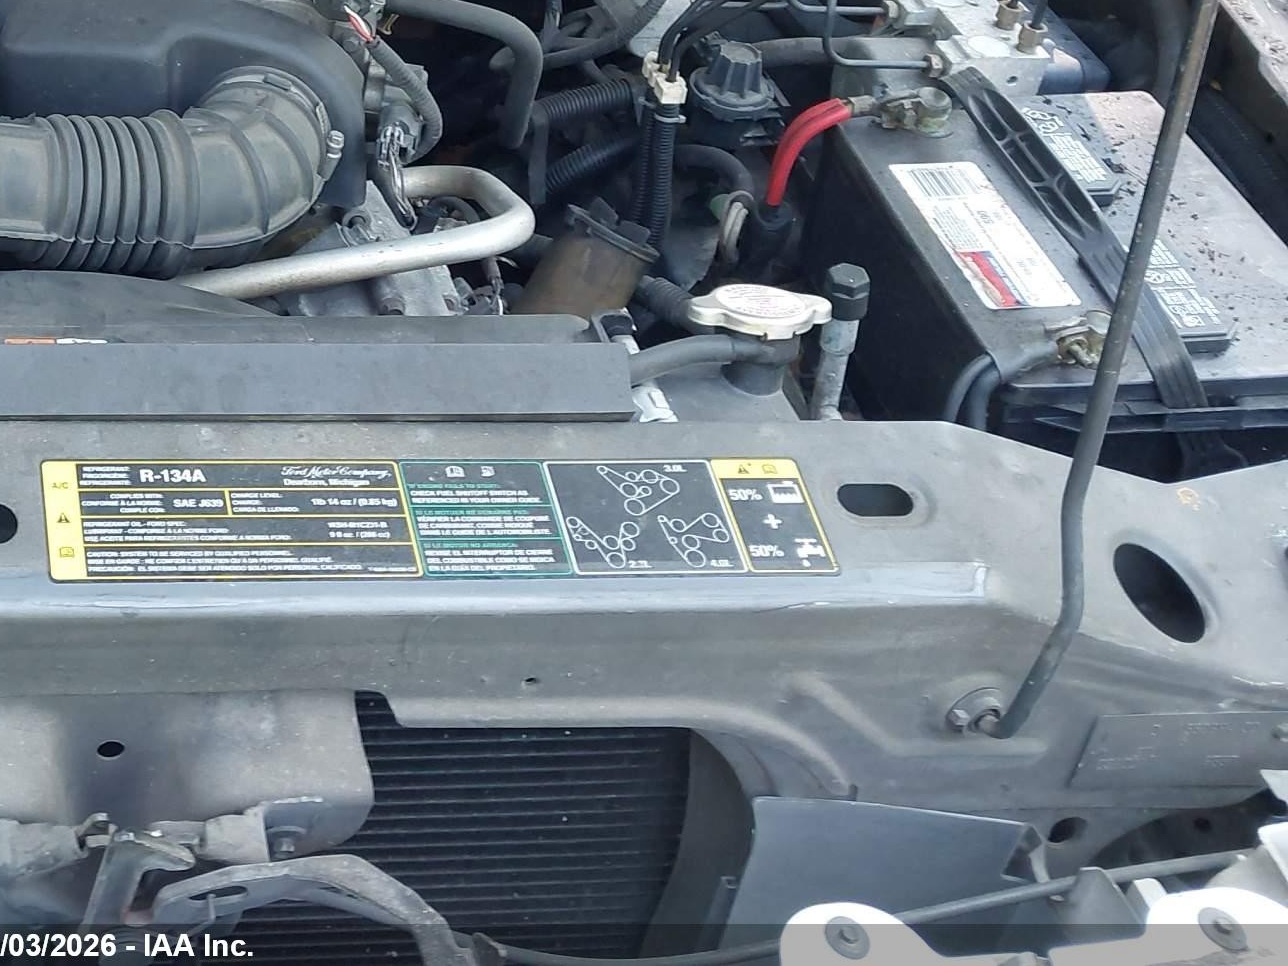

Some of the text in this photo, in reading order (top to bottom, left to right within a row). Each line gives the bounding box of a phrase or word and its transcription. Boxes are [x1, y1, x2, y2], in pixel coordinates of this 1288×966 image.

[139, 468, 207, 483] R-134A
[280, 466, 309, 476] Ford
[728, 488, 763, 501] 50%
[172, 498, 197, 508] SAE
[749, 545, 785, 558] 50%
